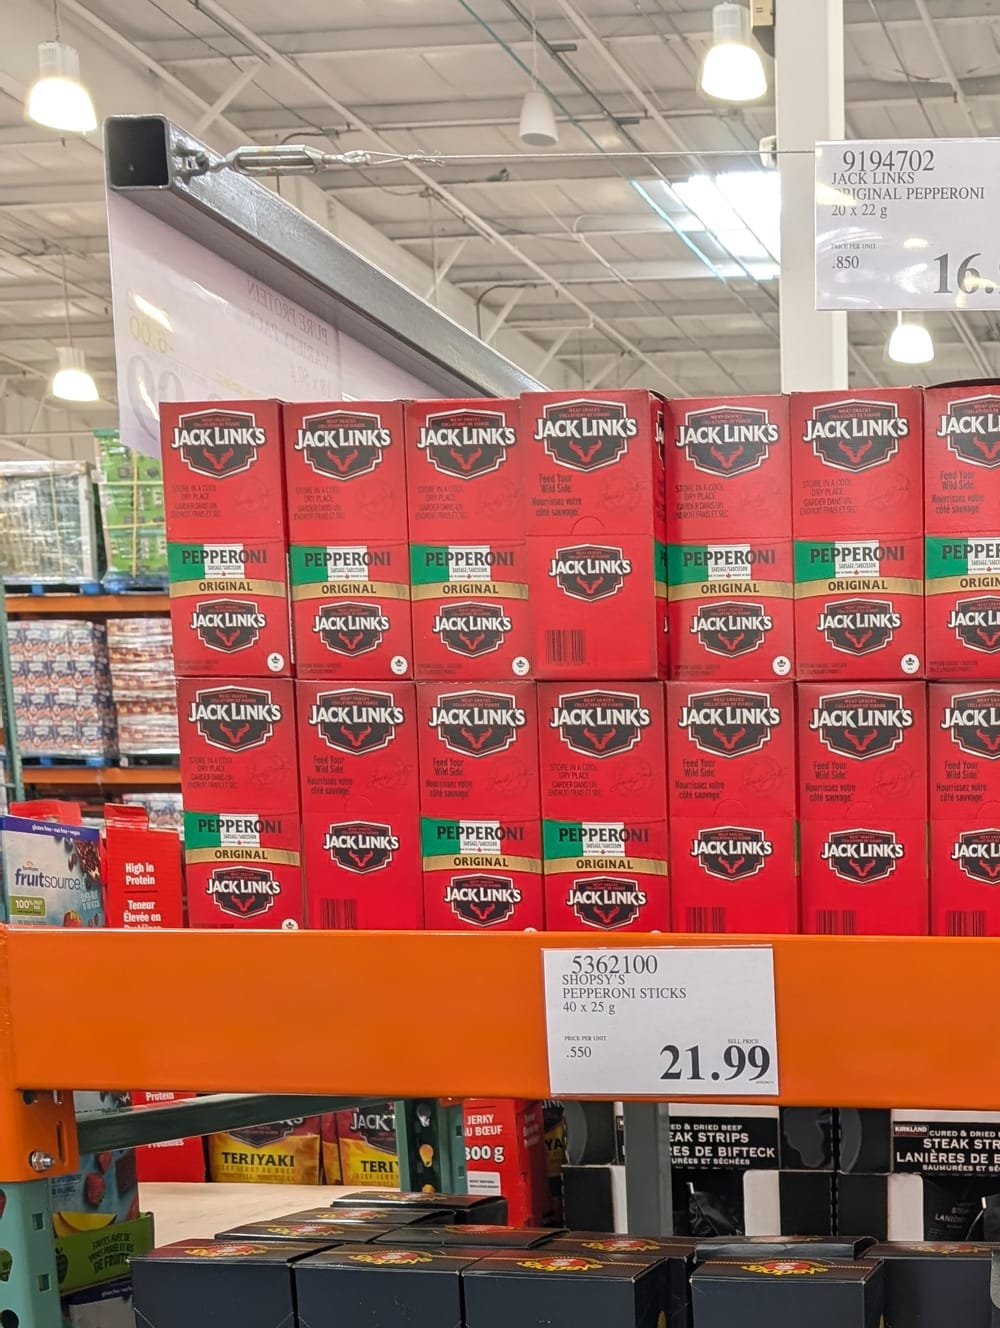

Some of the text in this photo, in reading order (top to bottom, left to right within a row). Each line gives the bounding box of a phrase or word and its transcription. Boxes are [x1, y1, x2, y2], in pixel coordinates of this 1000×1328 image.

[843, 150, 935, 172] 9194702
[832, 172, 915, 184] JACK LINKS
[907, 187, 986, 200] PEPPERONI
[832, 204, 887, 219] 20 x 22 g
[832, 256, 859, 270] .850
[171, 427, 266, 448] JACK LINK'S
[182, 549, 267, 565] PEPPERONI
[198, 581, 253, 592] ORIGINAL
[125, 863, 154, 873] High in
[15, 869, 81, 890] fruitsource
[126, 876, 155, 885] Protein
[128, 900, 155, 910] Teneur
[124, 911, 150, 922] Élevée
[572, 955, 658, 974] 5362100
[562, 974, 625, 985] SHOPSY'S
[563, 988, 687, 999] PEPPERONI STICKS
[563, 1002, 577, 1012] 40
[591, 1002, 604, 1012] 25
[609, 1004, 615, 1015] g
[566, 1047, 591, 1058] .550
[660, 1045, 770, 1081] 21.99
[466, 1114, 495, 1126] JERKY
[894, 1126, 928, 1134] KIRKLAND
[970, 1130, 997, 1138] DRIED
[923, 1138, 969, 1150] STEAK
[221, 1151, 296, 1168] TERIYAKI
[896, 1149, 965, 1164] LANIÈRES
[970, 1153, 988, 1164] DE
